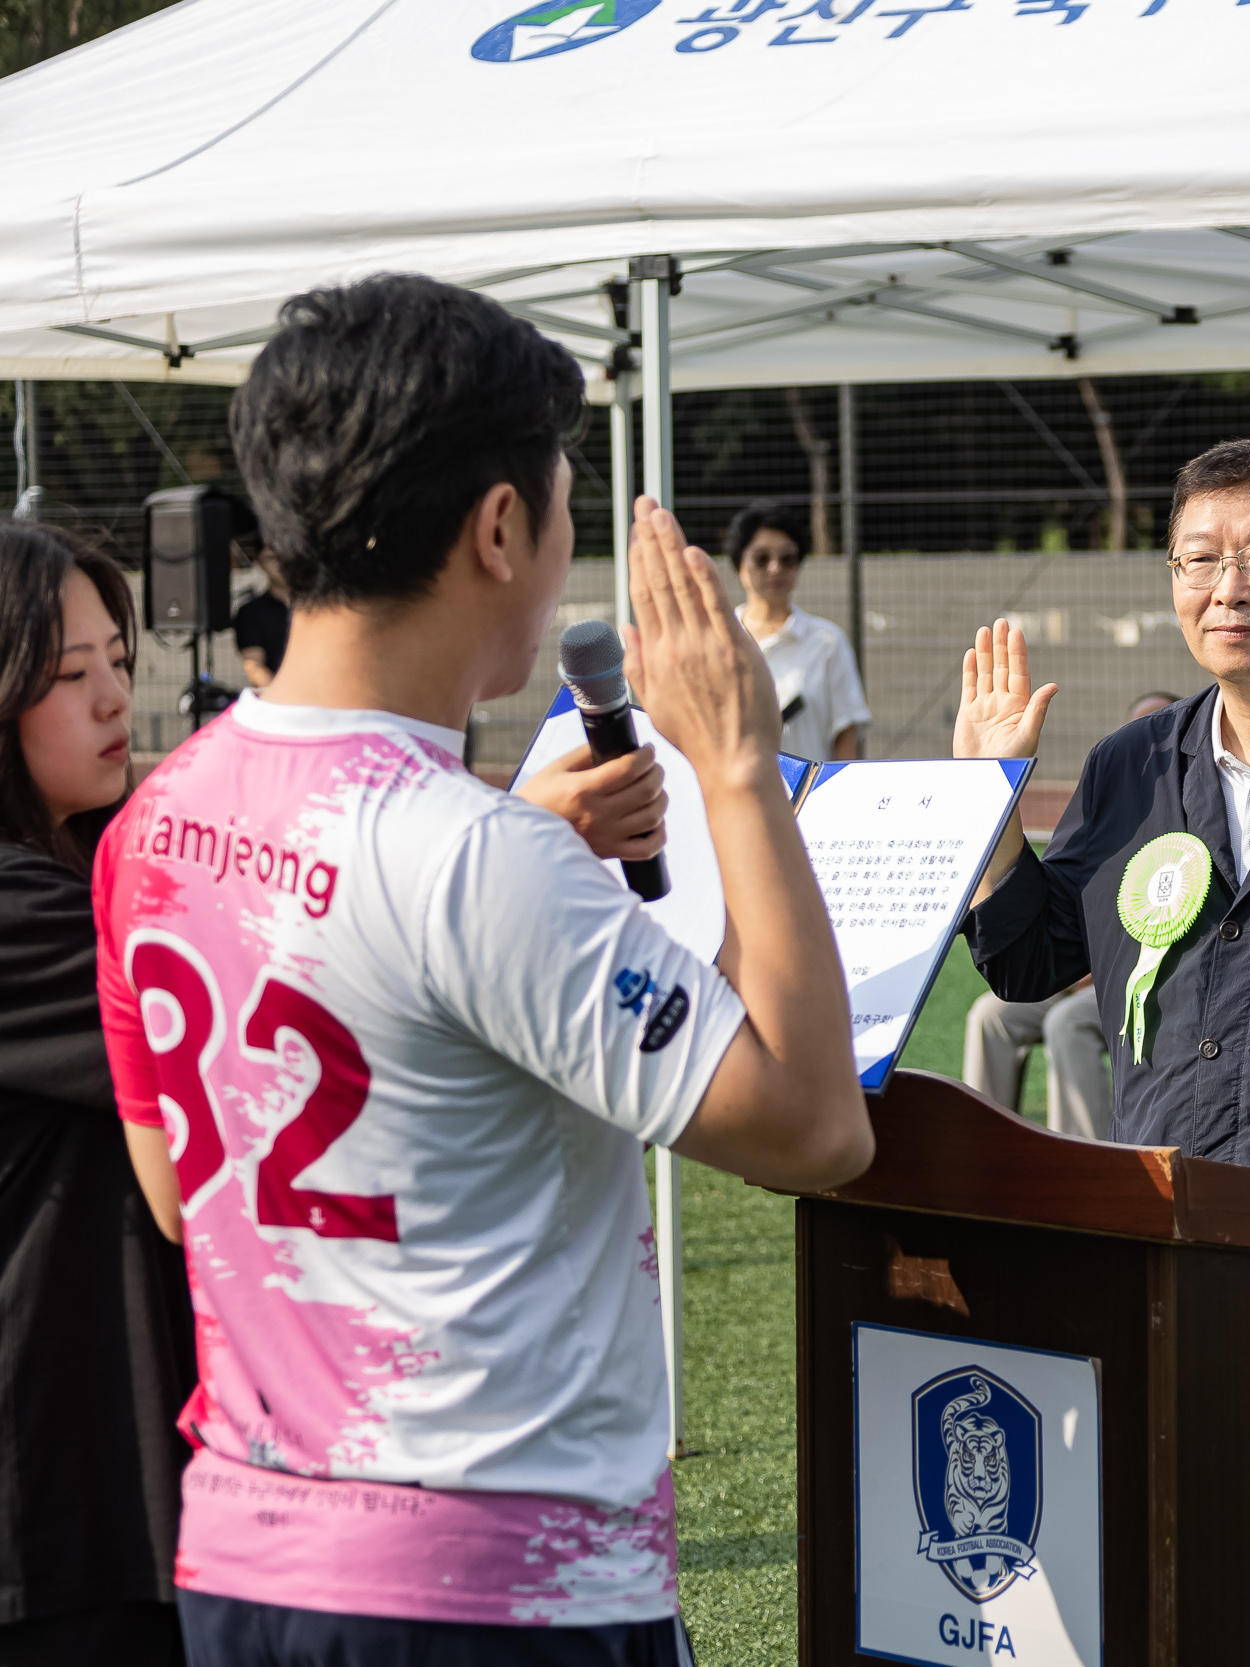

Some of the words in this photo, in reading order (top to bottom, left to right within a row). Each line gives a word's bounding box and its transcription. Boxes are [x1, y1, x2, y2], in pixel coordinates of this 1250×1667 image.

[878, 796, 891, 810] 선
[918, 795, 933, 810] 서
[936, 1545, 957, 1557] KOREA
[957, 1539, 985, 1554] FOOTBALL
[985, 1538, 1023, 1556] ASSOCIATION
[938, 1613, 1017, 1659] GJFA
